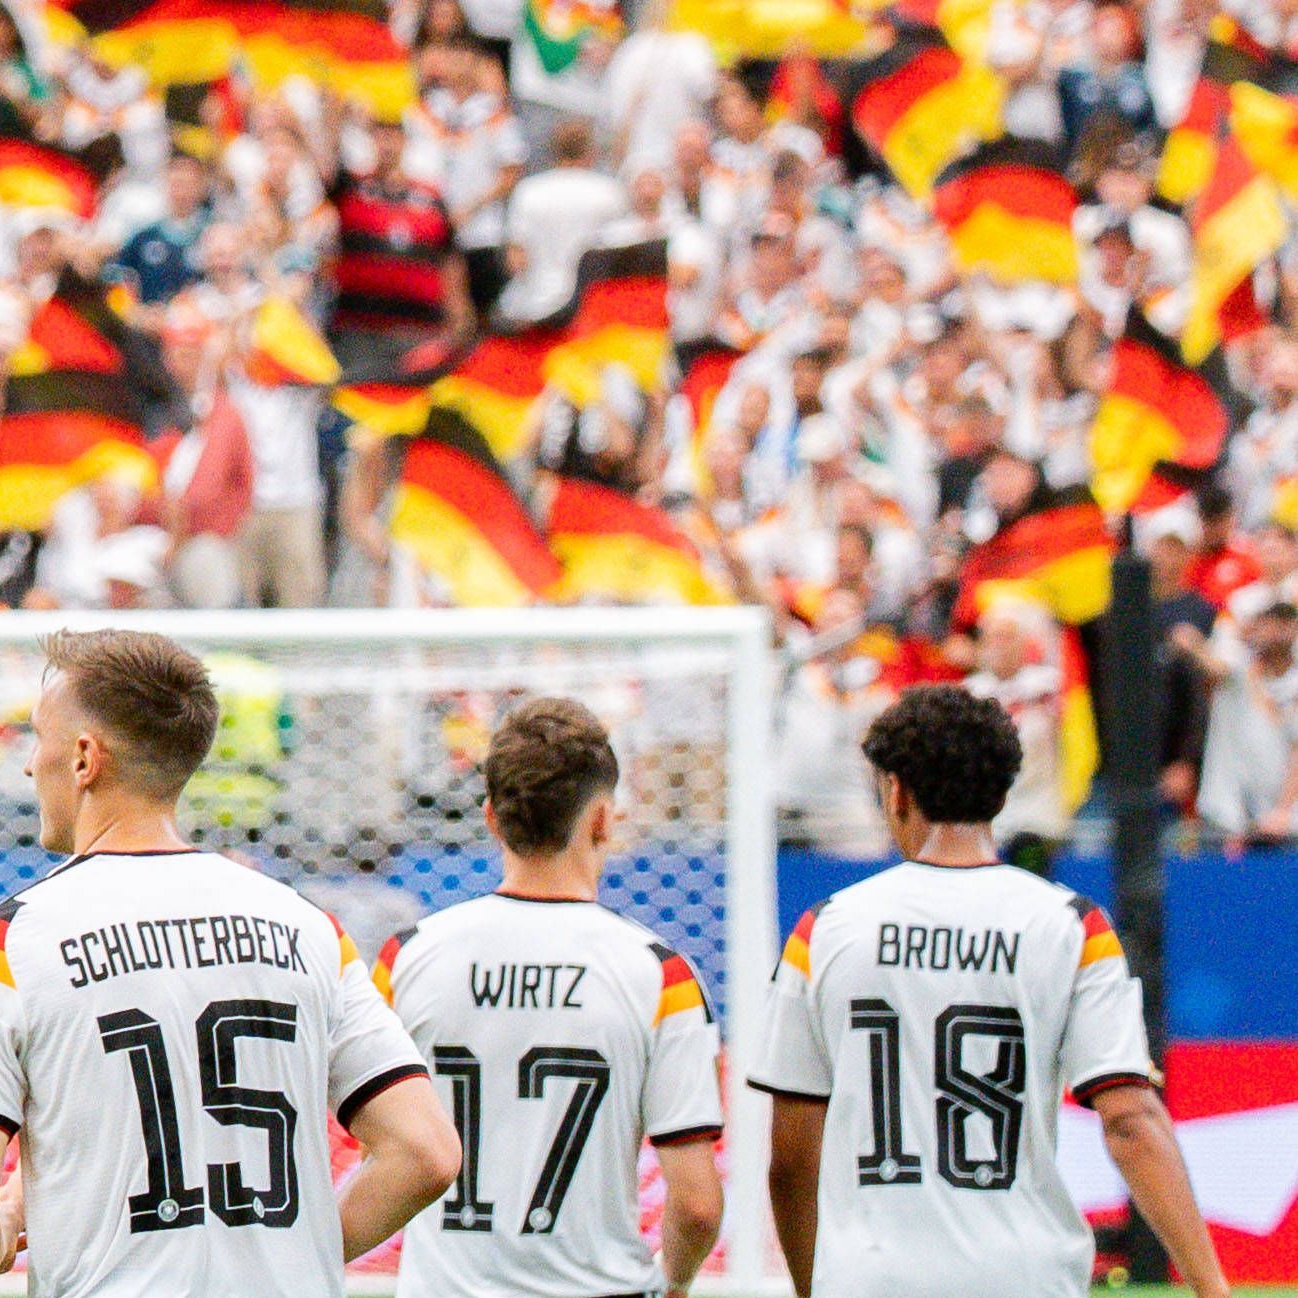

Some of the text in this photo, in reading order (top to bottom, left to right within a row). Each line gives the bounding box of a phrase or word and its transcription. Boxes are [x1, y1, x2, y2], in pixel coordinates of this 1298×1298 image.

[60, 914, 308, 989] SCHLOTTERBECK
[470, 962, 587, 1010] WIRTZ
[877, 923, 1021, 975] BROWN
[96, 998, 300, 1235] 15
[432, 1045, 612, 1235] 17
[850, 998, 1027, 1192] 18
